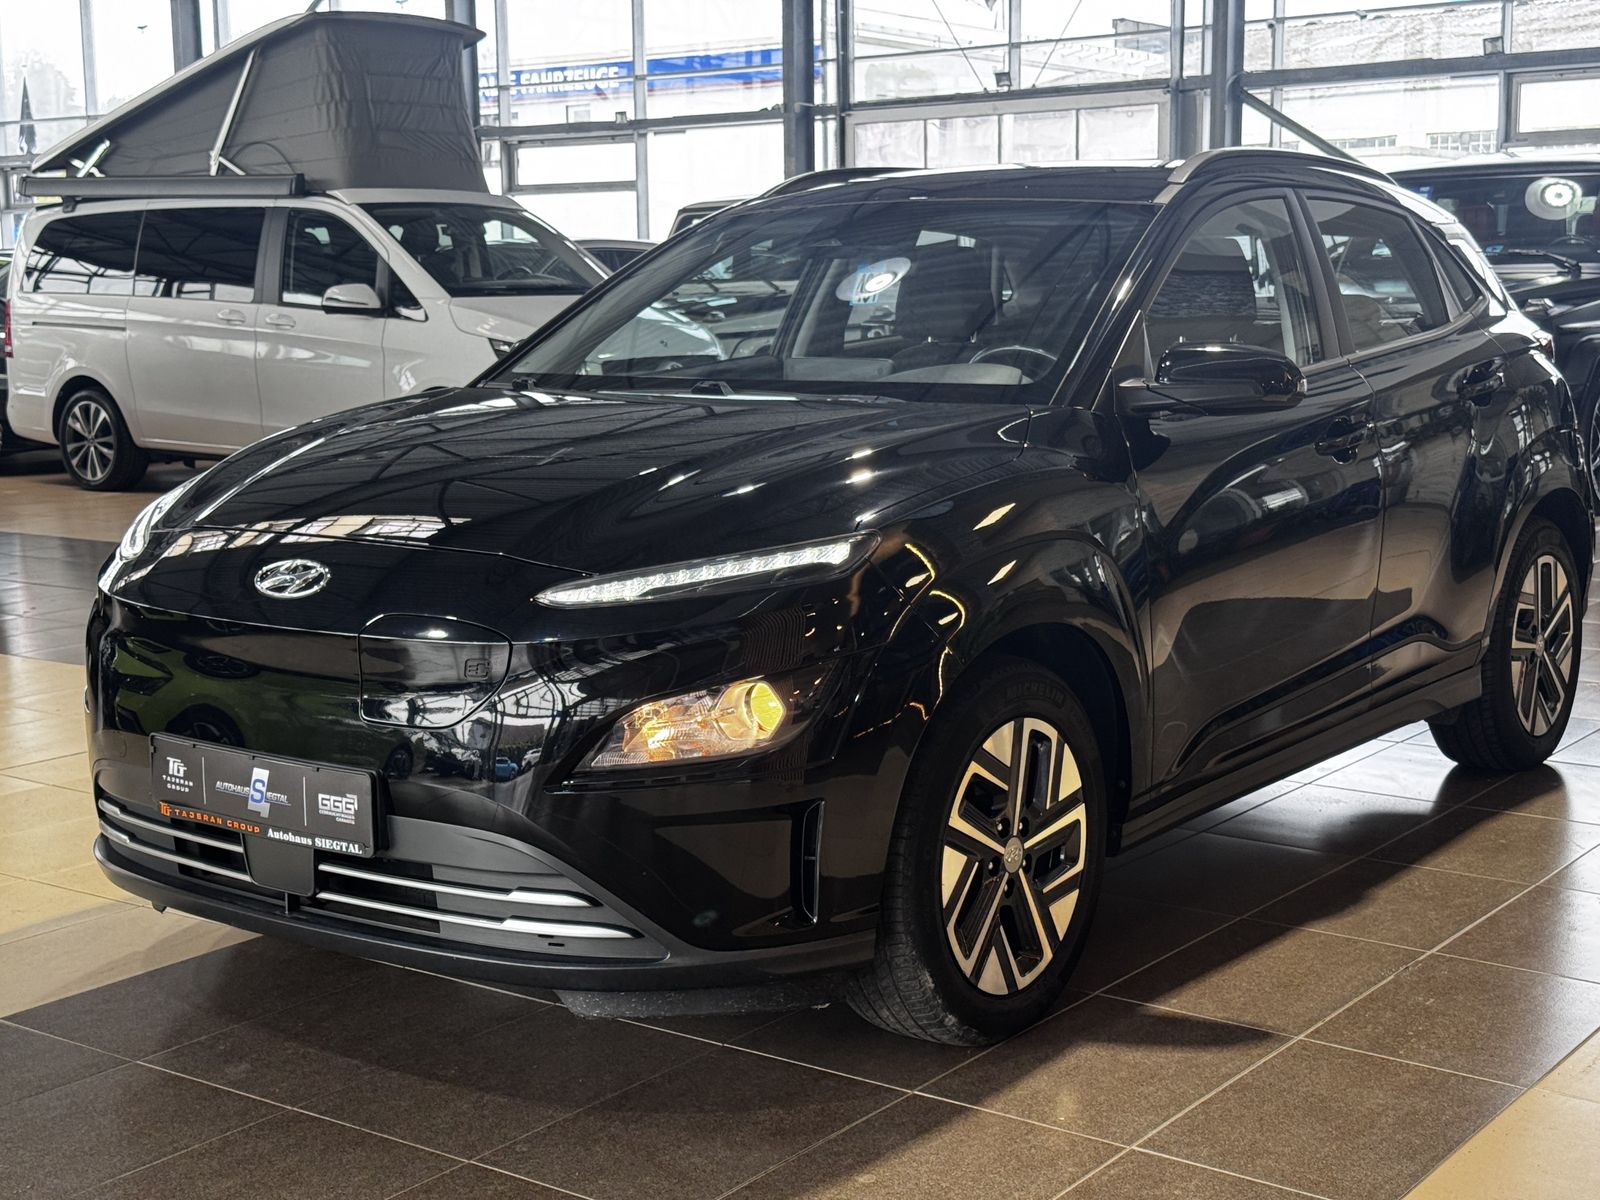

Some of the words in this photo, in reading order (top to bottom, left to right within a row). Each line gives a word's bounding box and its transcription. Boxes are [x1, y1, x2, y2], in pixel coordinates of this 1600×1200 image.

[520, 67, 619, 95] FAHRZEUGE
[167, 783, 190, 793] GROUP
[215, 781, 250, 795] AUTOHAUS
[318, 793, 356, 815] GGG
[174, 809, 222, 825] TAJERAN
[226, 820, 260, 834] GROUP
[267, 828, 312, 846] Autohaus
[314, 837, 362, 854] SIEGTAL
